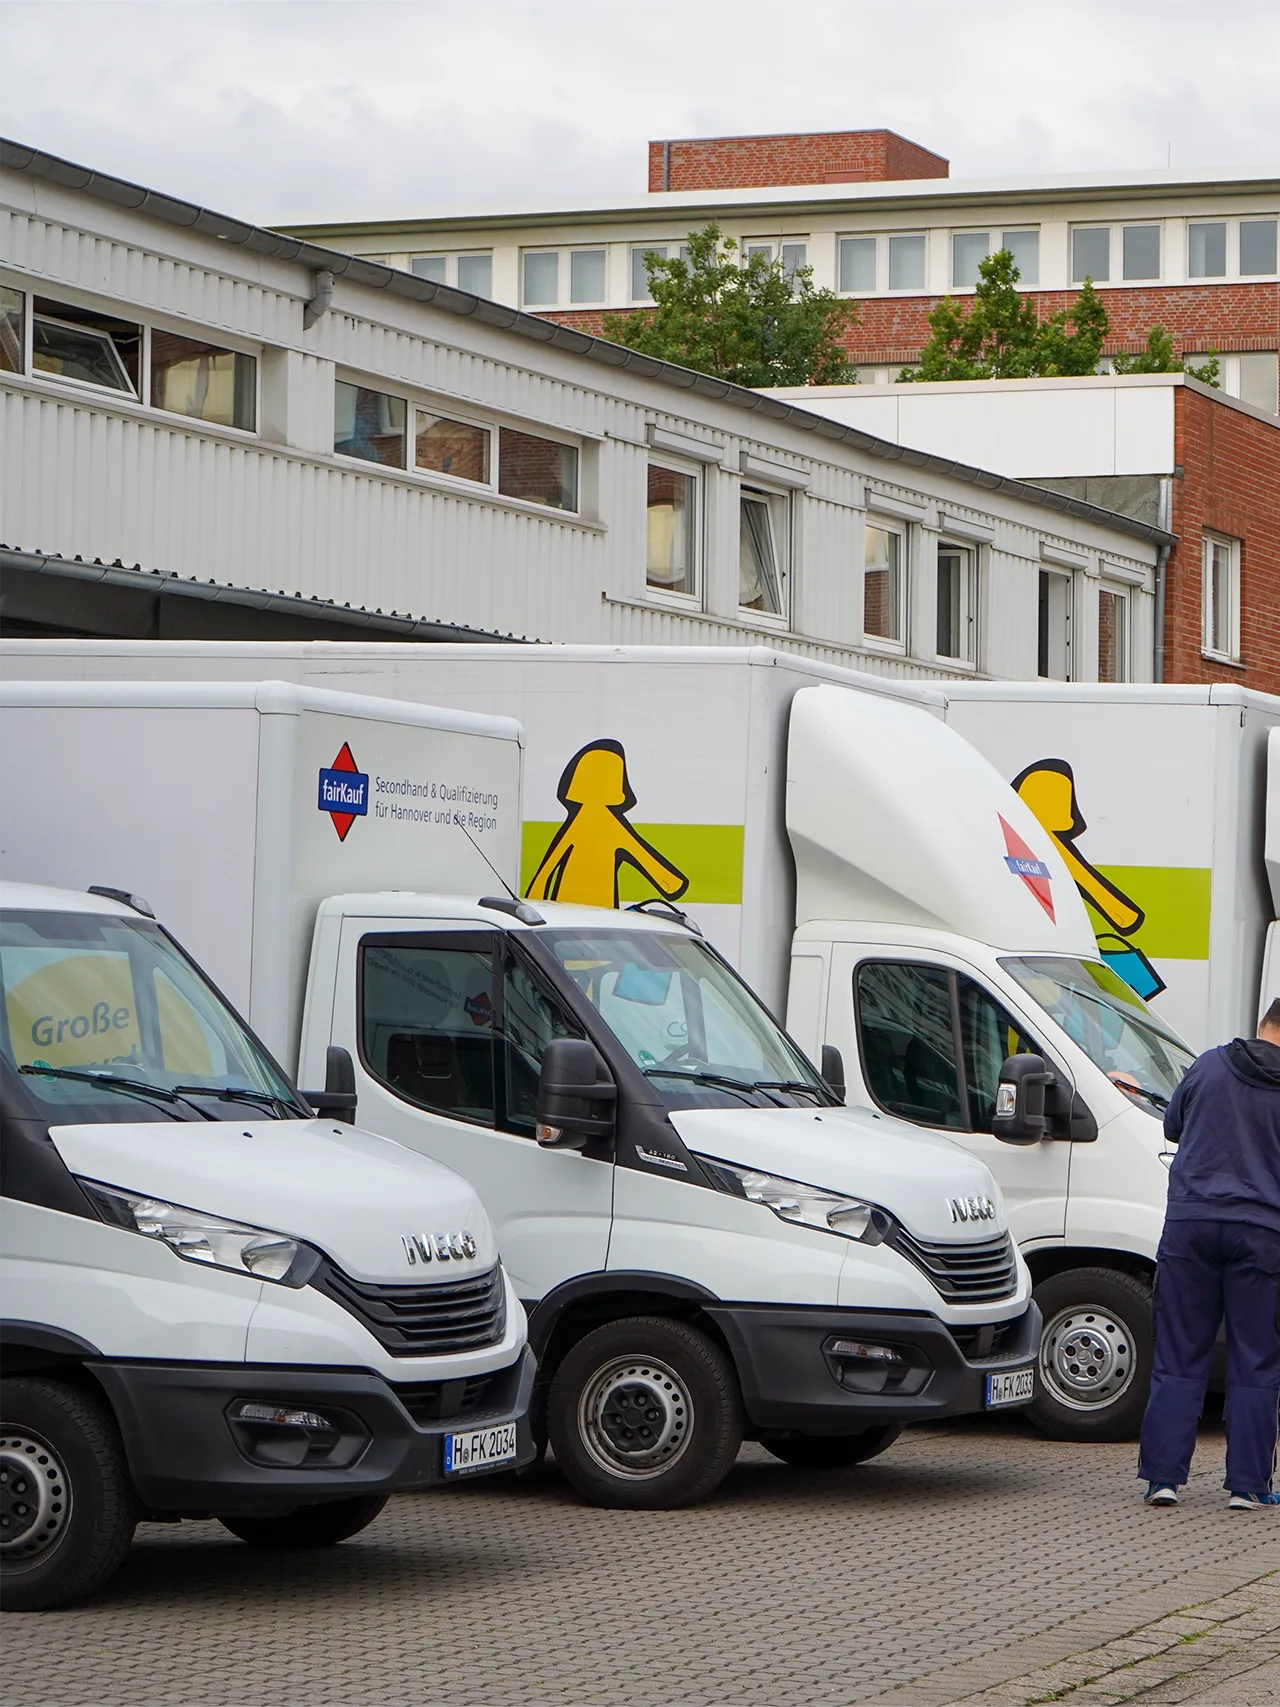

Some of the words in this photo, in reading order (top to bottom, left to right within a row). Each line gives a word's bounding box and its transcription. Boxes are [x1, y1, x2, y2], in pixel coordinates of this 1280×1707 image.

[323, 779, 364, 805] fairKauf
[375, 777, 428, 798] Secondhand
[431, 784, 437, 798] &
[439, 784, 499, 810] Qualifizierung
[375, 801, 388, 818] für
[391, 804, 433, 822] Hannover
[435, 809, 451, 825] und
[453, 811, 466, 827] die
[468, 812, 497, 833] Region
[31, 1002, 130, 1047] Große
[945, 1196, 996, 1223] IVECO
[400, 1230, 477, 1265] IVECO
